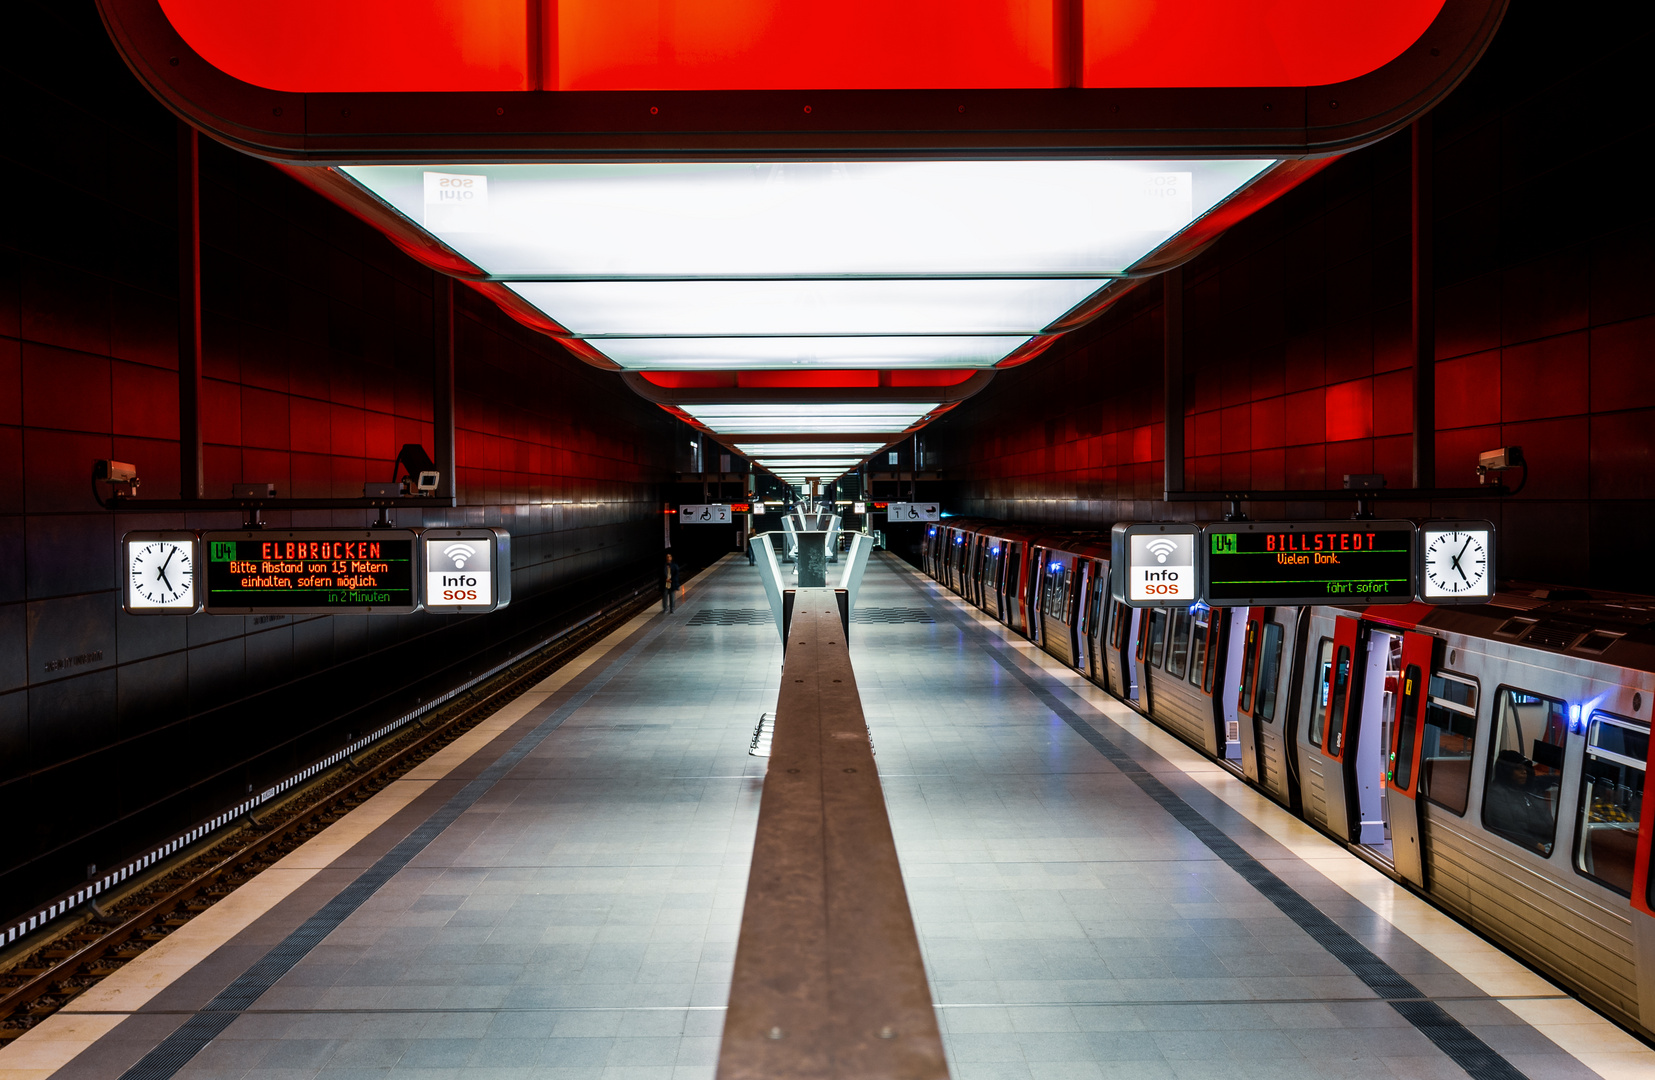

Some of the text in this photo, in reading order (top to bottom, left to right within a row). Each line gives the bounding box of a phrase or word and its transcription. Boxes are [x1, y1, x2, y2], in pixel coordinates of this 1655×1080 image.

[719, 512, 725, 520] 2
[895, 511, 899, 519] 1
[1216, 533, 1376, 551] U4 BILLSTEDT
[215, 542, 380, 560] U4 ELBBRÜCKEN
[1277, 552, 1341, 565] Vielen Dank.
[229, 561, 257, 574] Bitte
[261, 561, 303, 573] Abstand
[308, 564, 327, 573] von
[351, 561, 388, 573] Metern
[442, 575, 477, 587] Info
[1144, 570, 1179, 581] Info
[241, 575, 377, 589] einhalten, sofern möglich.
[1326, 581, 1389, 593] fährt sofort
[442, 589, 477, 601] SOS
[1144, 584, 1179, 595] SOS
[327, 591, 391, 603] in 2 Minuten
